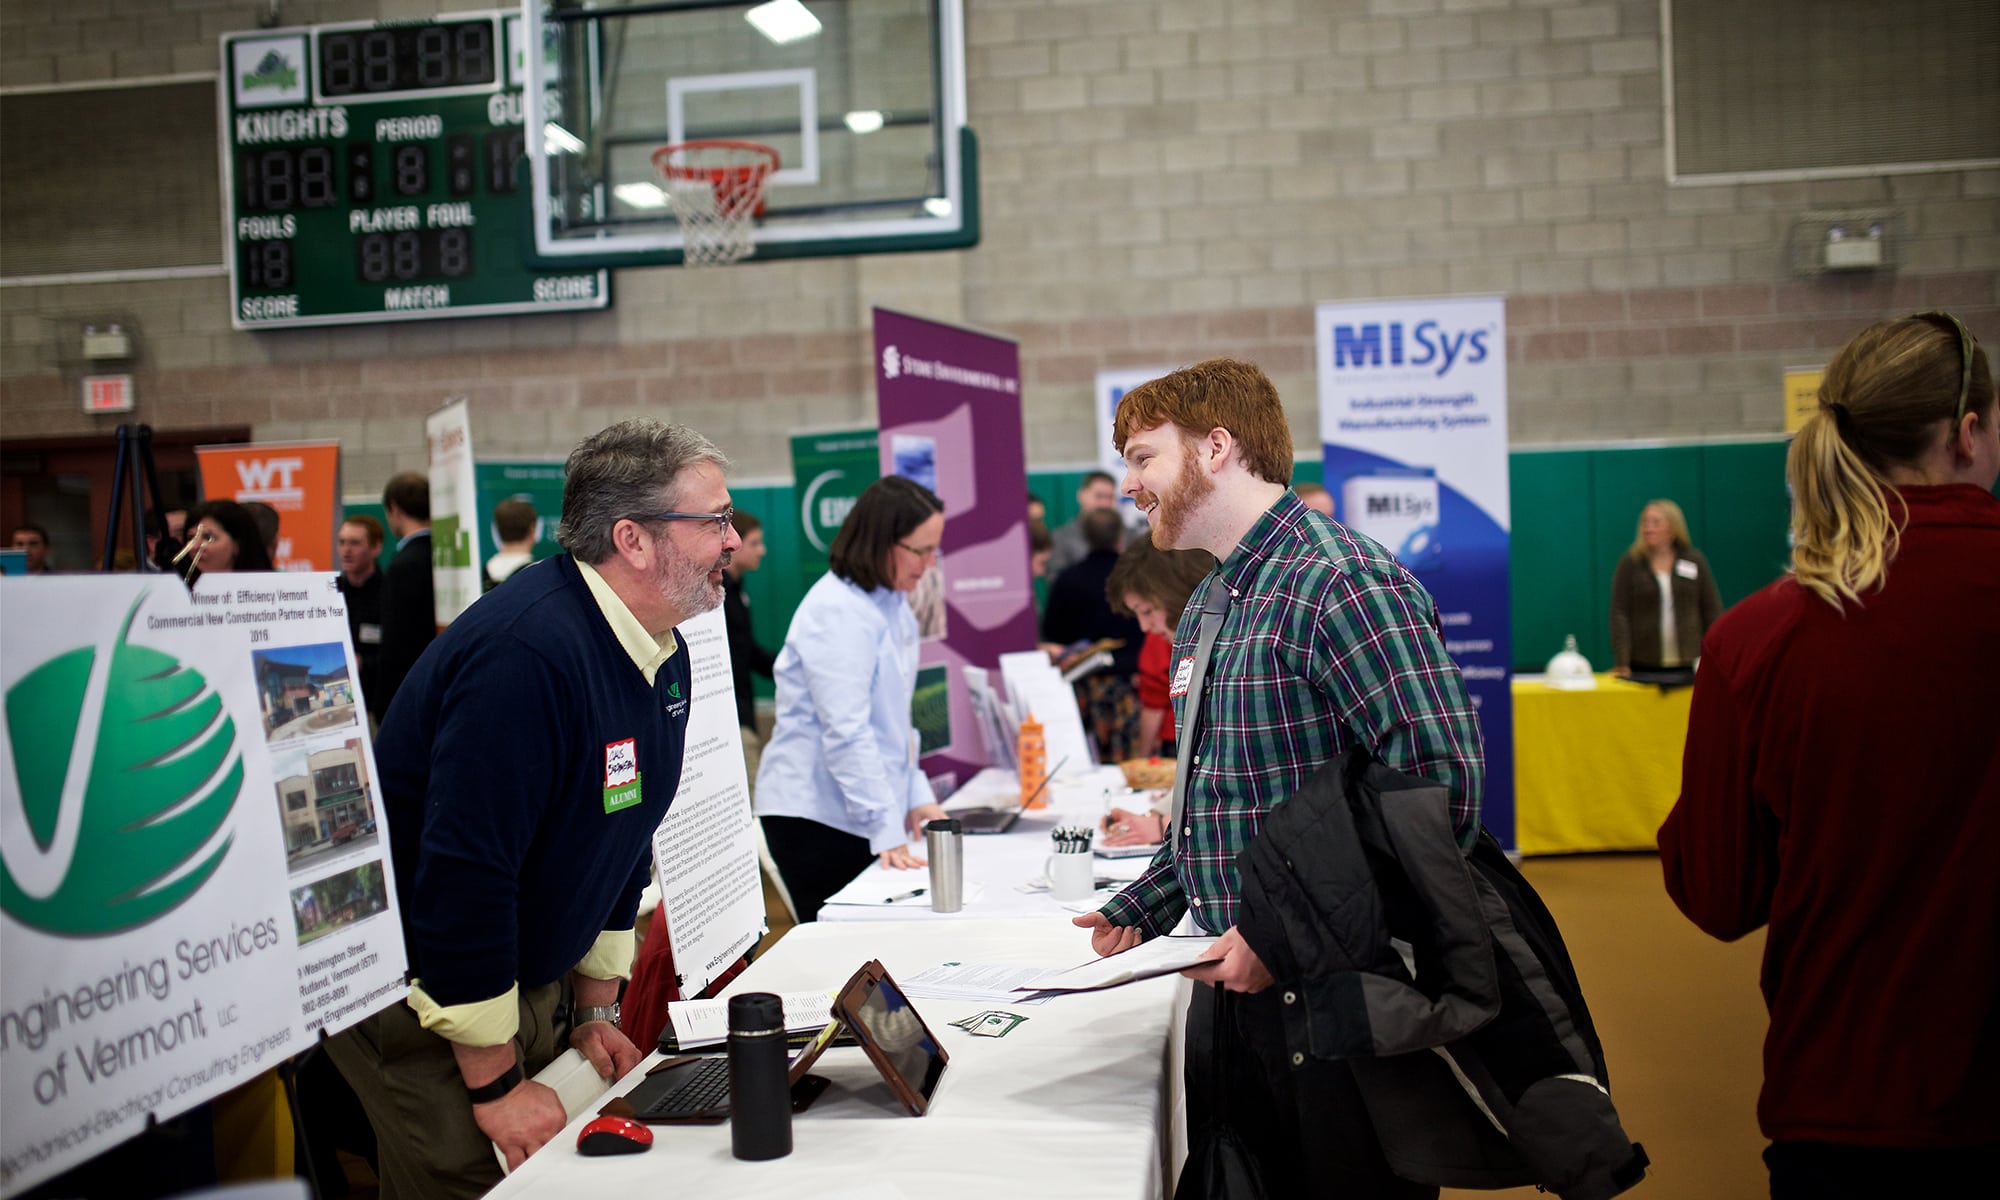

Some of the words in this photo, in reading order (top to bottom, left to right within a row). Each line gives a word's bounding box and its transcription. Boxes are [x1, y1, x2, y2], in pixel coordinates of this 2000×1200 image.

[236, 107, 348, 144] KNIGHTS
[375, 115, 443, 142] PERIOD
[238, 214, 296, 240] FOULS
[350, 206, 419, 233] PLAYER
[427, 202, 476, 228] FOUL
[385, 285, 450, 311] MATCH
[533, 276, 595, 301] SCORE
[242, 296, 299, 321] SCORE
[1334, 321, 1489, 377] MISys
[190, 592, 219, 606] Winner
[237, 590, 275, 606] Efficiency
[277, 589, 308, 602] Vermont
[148, 612, 203, 630] Commercial
[205, 612, 223, 626] New
[225, 609, 277, 625] Construction
[278, 607, 305, 621] Partner
[307, 606, 314, 618] of
[315, 606, 327, 618] the
[327, 605, 344, 617] Year
[609, 788, 637, 806] ALUMNI
[304, 951, 347, 976] Washington
[347, 942, 366, 959] Street
[0, 957, 170, 1051] ngineering
[176, 917, 280, 980] Services
[331, 963, 361, 982] Vermont
[34, 1052, 67, 1107] of
[217, 1004, 240, 1029] LLC
[167, 1054, 238, 1100] Consulting
[241, 1027, 292, 1064] Engineers
